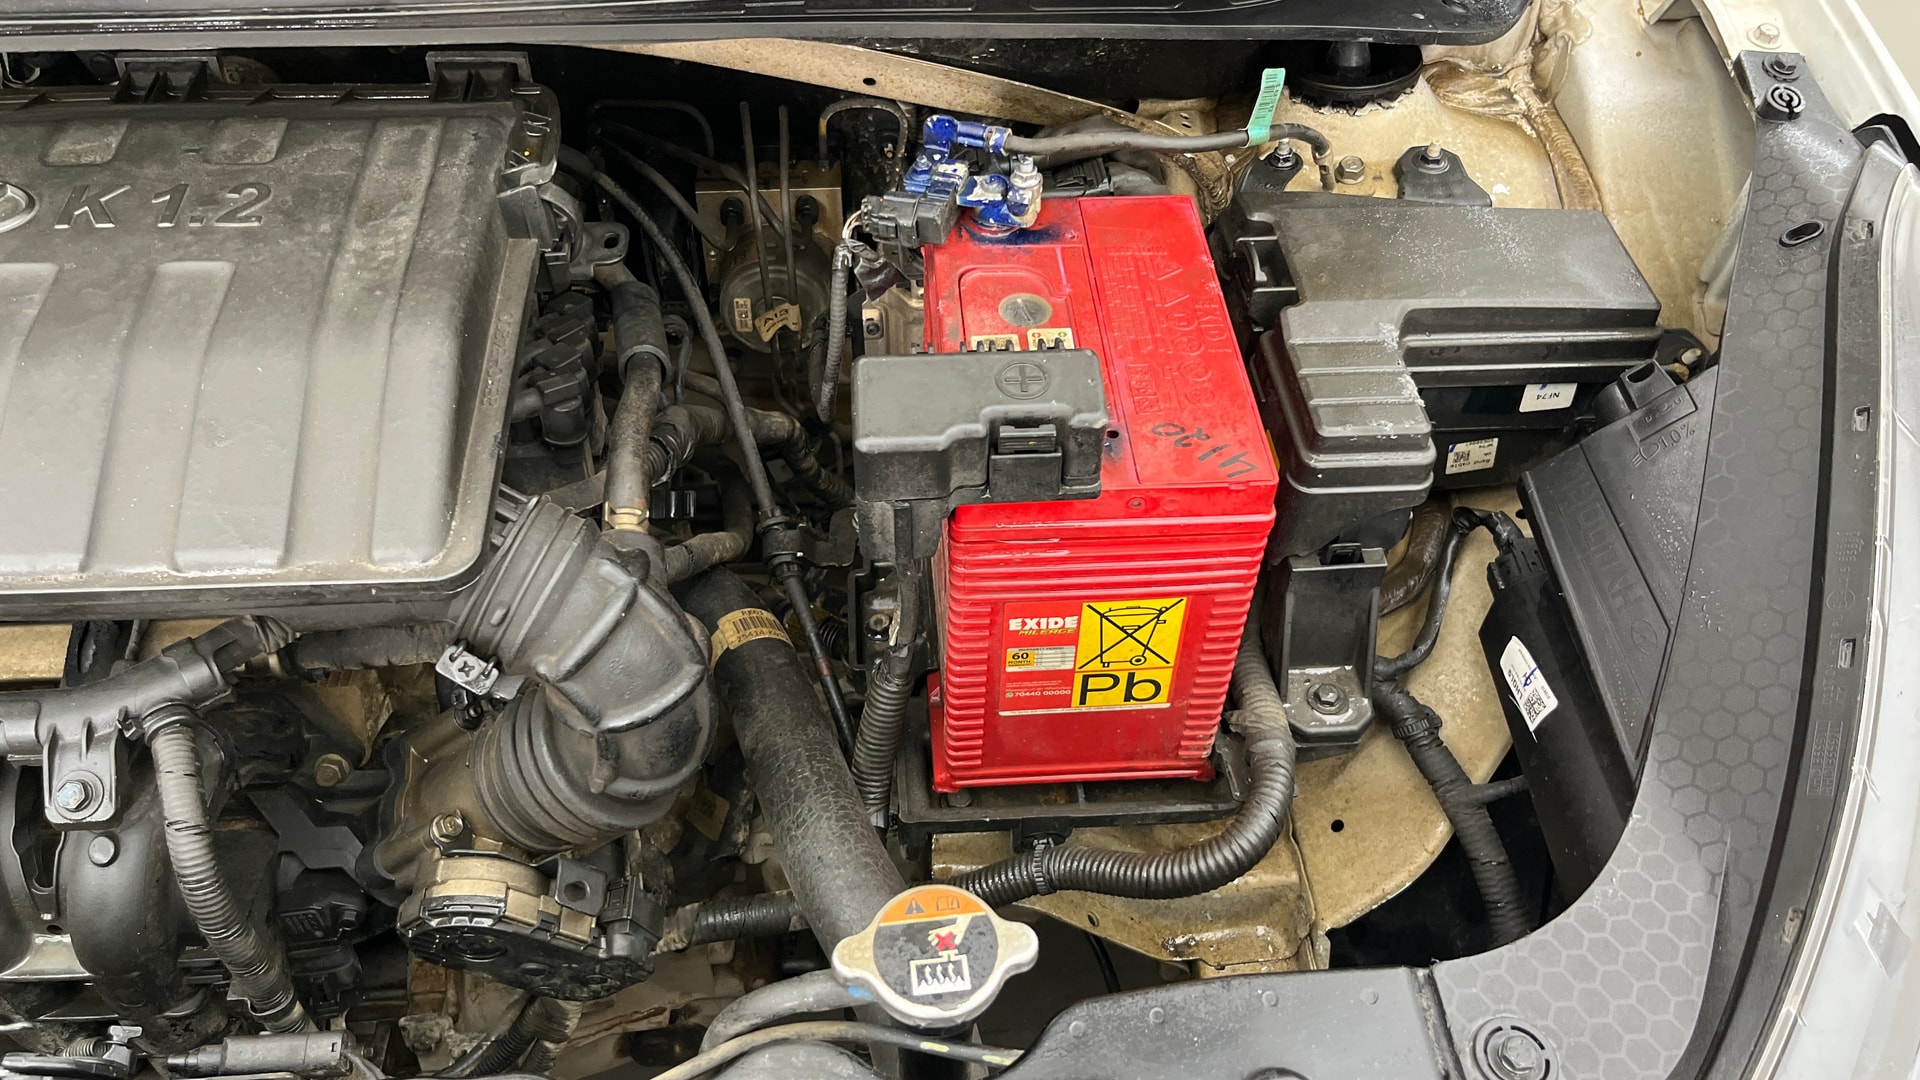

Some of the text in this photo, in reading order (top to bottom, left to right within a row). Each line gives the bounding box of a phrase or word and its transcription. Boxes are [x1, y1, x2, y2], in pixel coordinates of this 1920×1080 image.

[54, 182, 273, 230] K 1.2
[1008, 616, 1079, 631] EXIDE
[1012, 652, 1030, 660] 60
[1079, 672, 1162, 705] Pb
